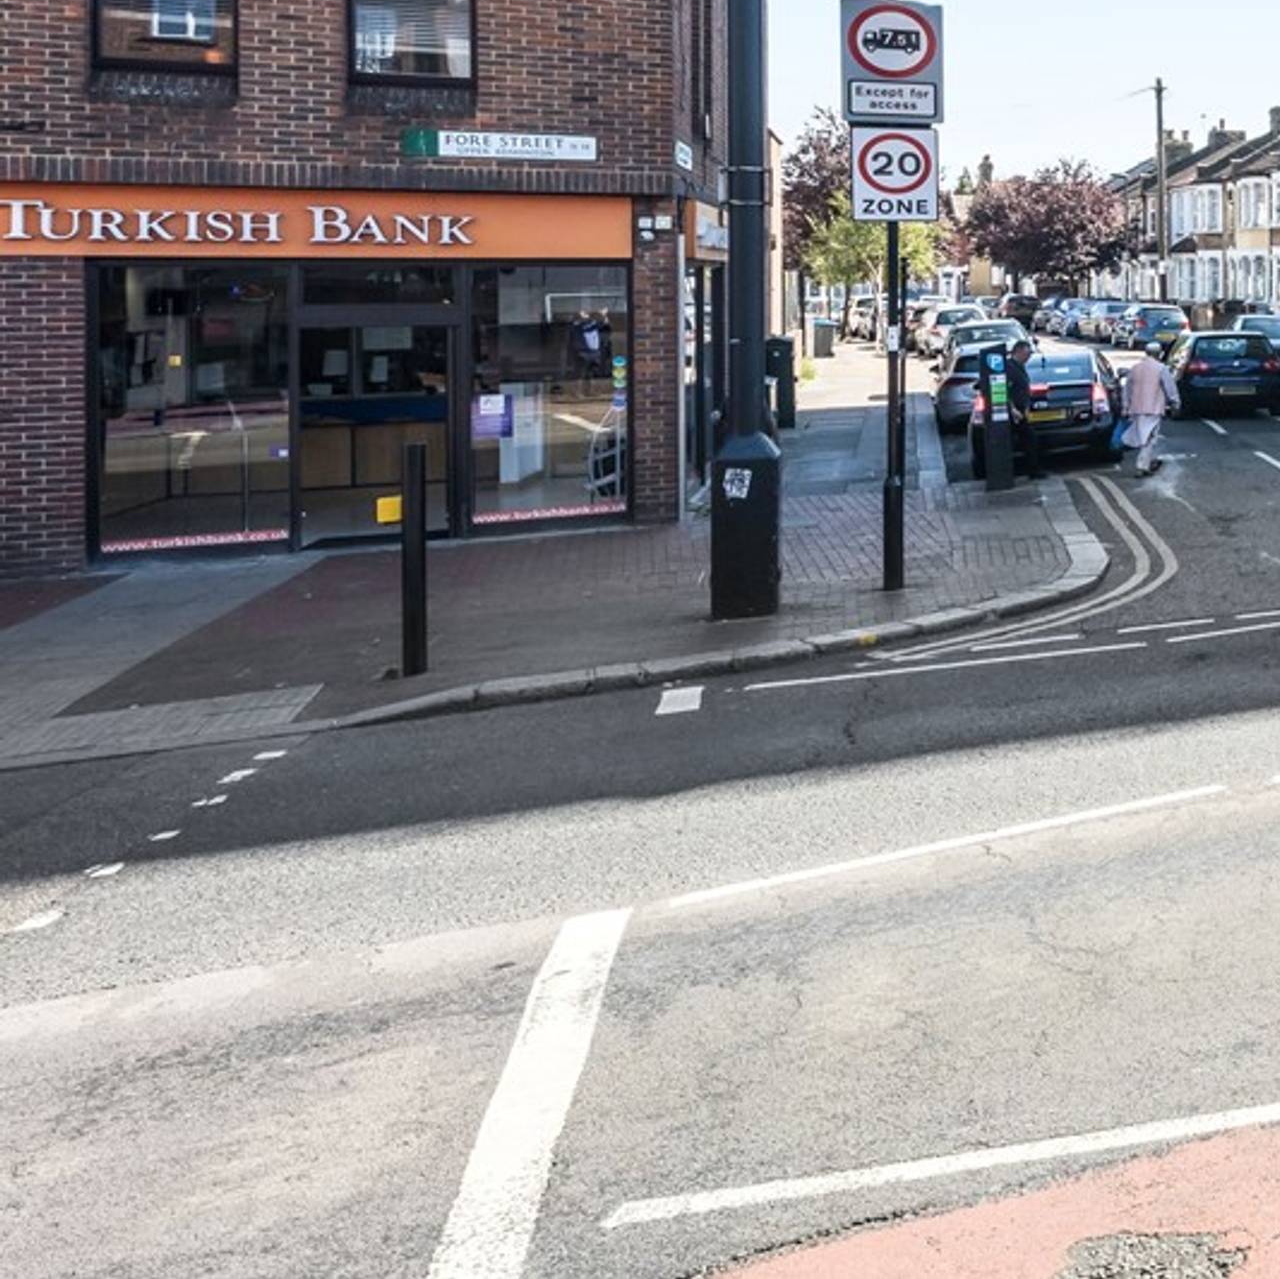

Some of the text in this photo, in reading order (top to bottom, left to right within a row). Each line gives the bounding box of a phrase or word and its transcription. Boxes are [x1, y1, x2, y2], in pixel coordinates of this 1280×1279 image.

[855, 86, 930, 99] Except for
[868, 102, 918, 110] access
[444, 134, 490, 148] FORE
[499, 135, 564, 149] STREET
[872, 151, 921, 176] 20
[862, 199, 929, 215] ZONE
[0, 199, 473, 245] TURKISH BANK
[100, 529, 289, 553] www.turkishbank.co.uk
